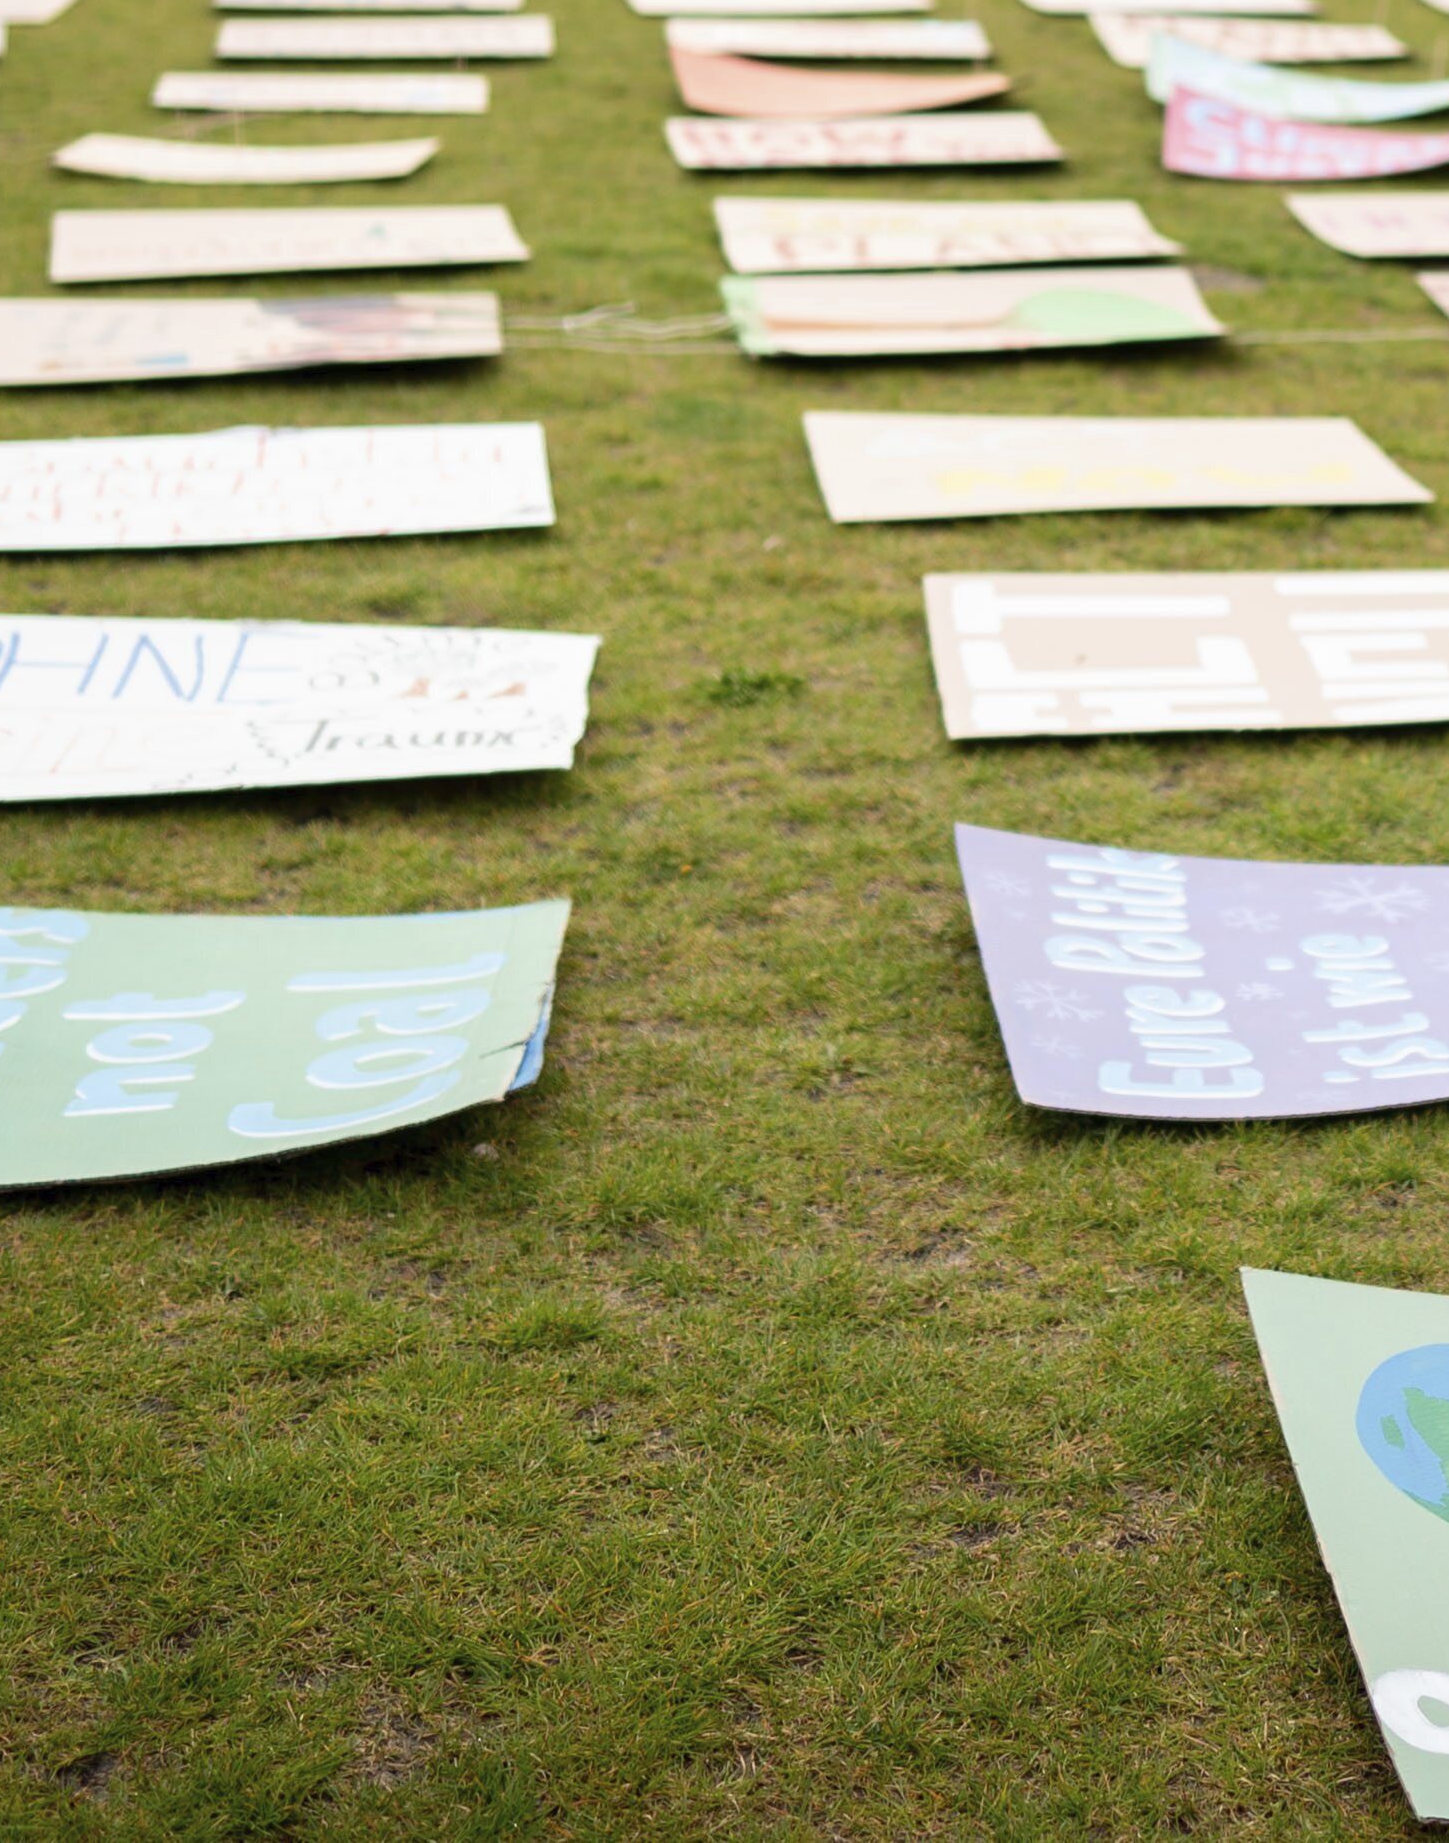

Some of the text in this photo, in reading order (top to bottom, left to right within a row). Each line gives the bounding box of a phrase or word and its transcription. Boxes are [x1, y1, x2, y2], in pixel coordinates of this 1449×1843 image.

[227, 950, 506, 1139] Coal
[1042, 845, 1264, 1100] Eure Politik
[1266, 933, 1414, 1010] wie
[62, 990, 247, 1117] not
